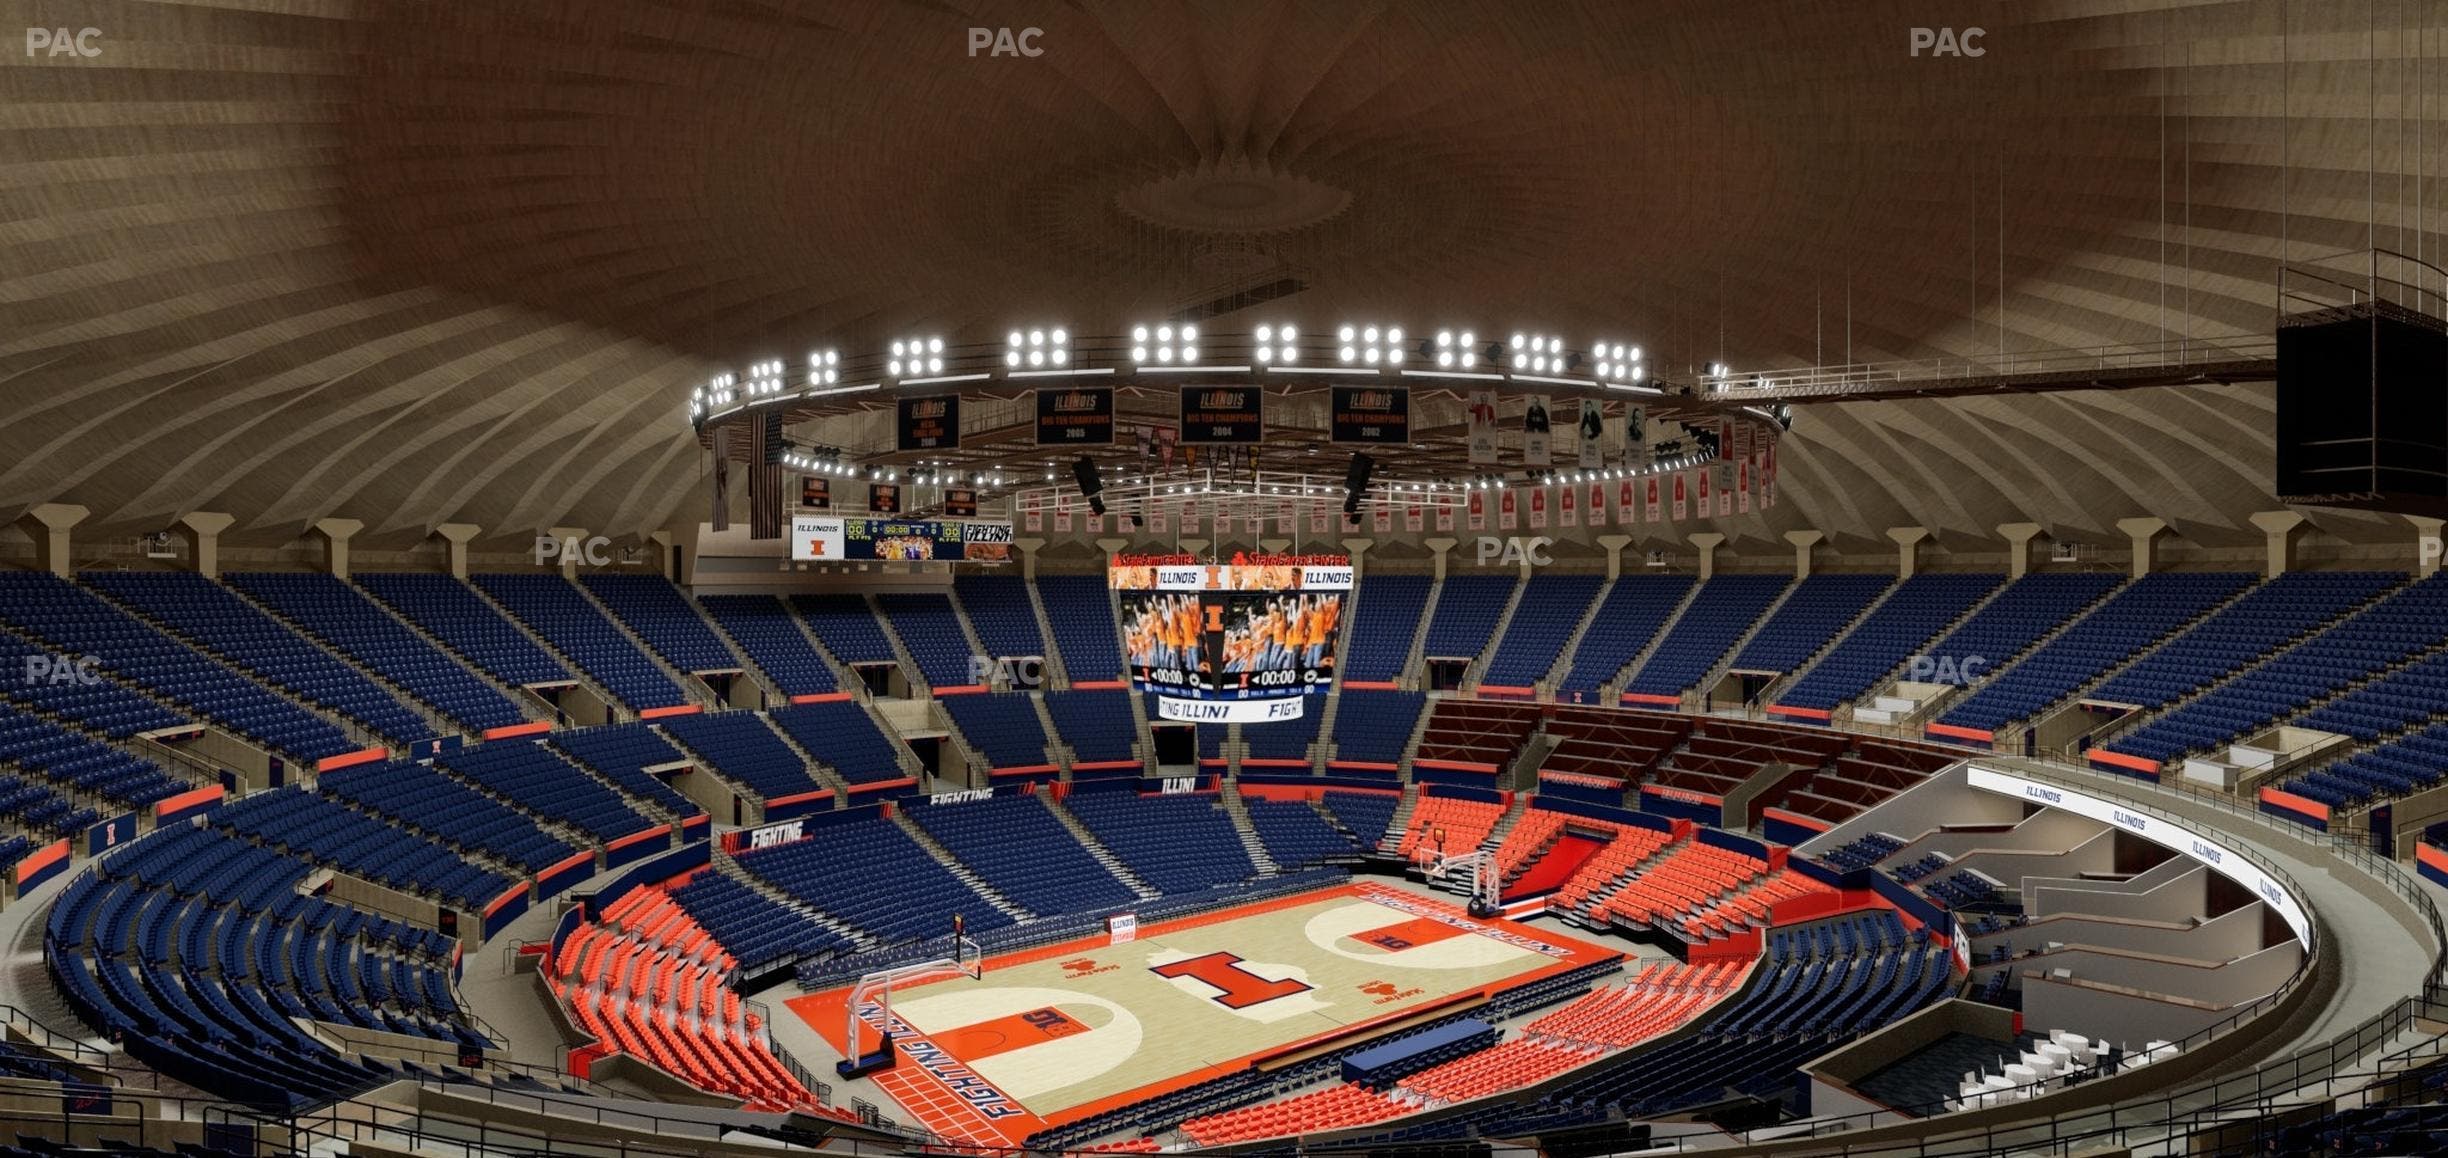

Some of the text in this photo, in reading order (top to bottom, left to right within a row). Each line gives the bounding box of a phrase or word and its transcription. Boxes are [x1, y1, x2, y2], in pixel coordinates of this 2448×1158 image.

[1055, 394, 1098, 409] ILLINOIS
[1200, 392, 1245, 407] ILLINOIS
[1350, 392, 1393, 408] ILLINOIS
[912, 400, 947, 417] ILLINOIS
[798, 524, 838, 533] ILLINOIS
[1160, 572, 1198, 584] ILLINOIS
[1305, 572, 1352, 584] ILLINOIS
[1157, 668, 1184, 685] 00:00
[1261, 670, 1296, 685] 00:00
[1183, 704, 1230, 718] ILLINI
[1162, 777, 1195, 794] ILLINI
[930, 788, 994, 805] FIGHTING
[2026, 785, 2061, 804] ILLINOIS
[2113, 809, 2146, 831] ILLINOIS
[751, 822, 804, 849] FIGHTING
[2192, 840, 2222, 865] ILLINOIS
[896, 1040, 1028, 1121] FIGHTING
